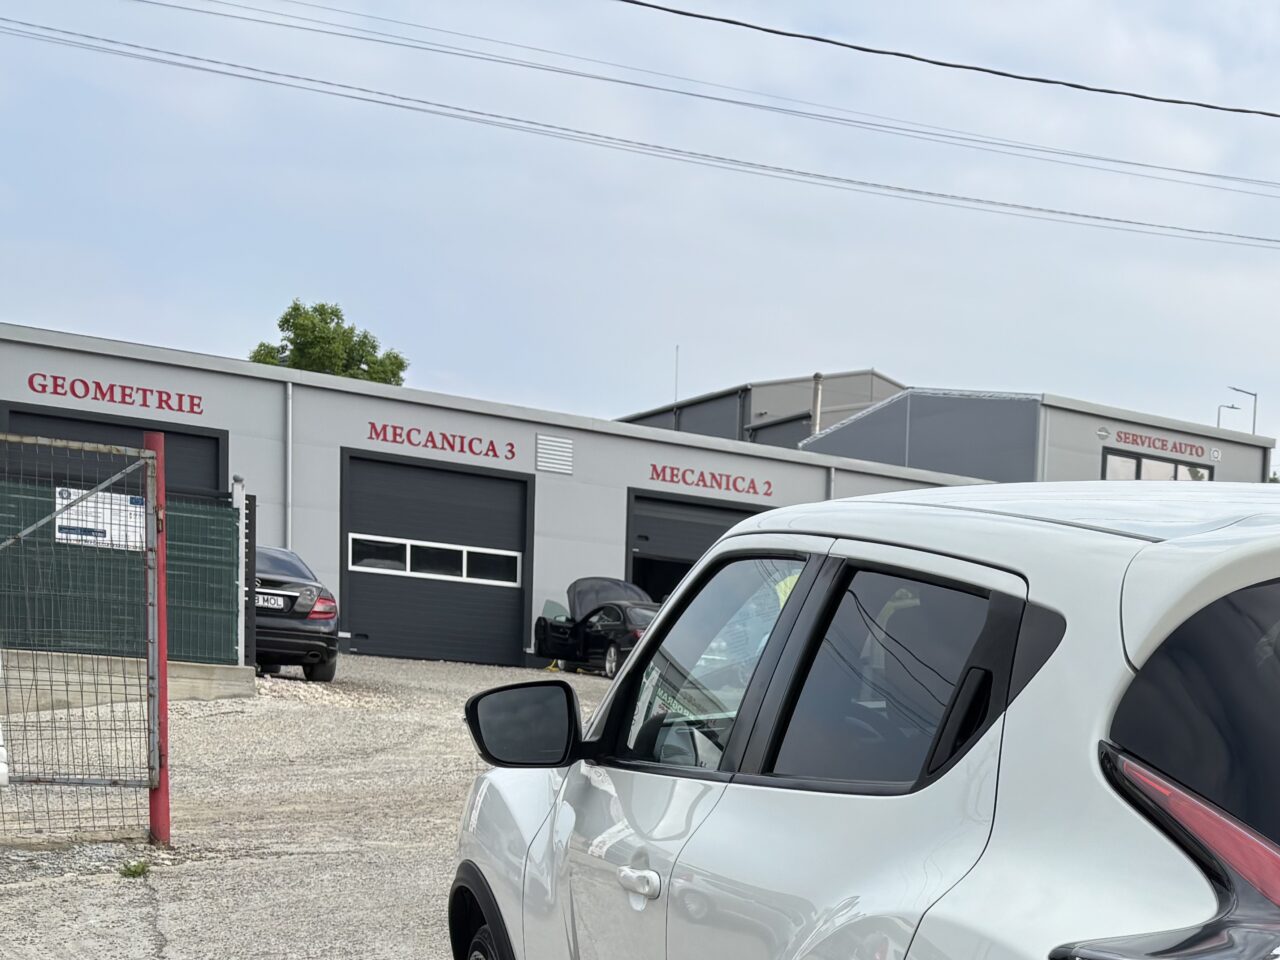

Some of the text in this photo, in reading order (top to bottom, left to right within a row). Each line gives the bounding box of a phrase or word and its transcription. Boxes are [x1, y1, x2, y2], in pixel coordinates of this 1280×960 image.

[27, 372, 204, 415] GEOMETRIE
[367, 421, 516, 460] MECANICA 3
[1115, 430, 1205, 458] SERVICE AUTO
[649, 463, 773, 497] MECANICA 2
[262, 596, 282, 607] MOL
